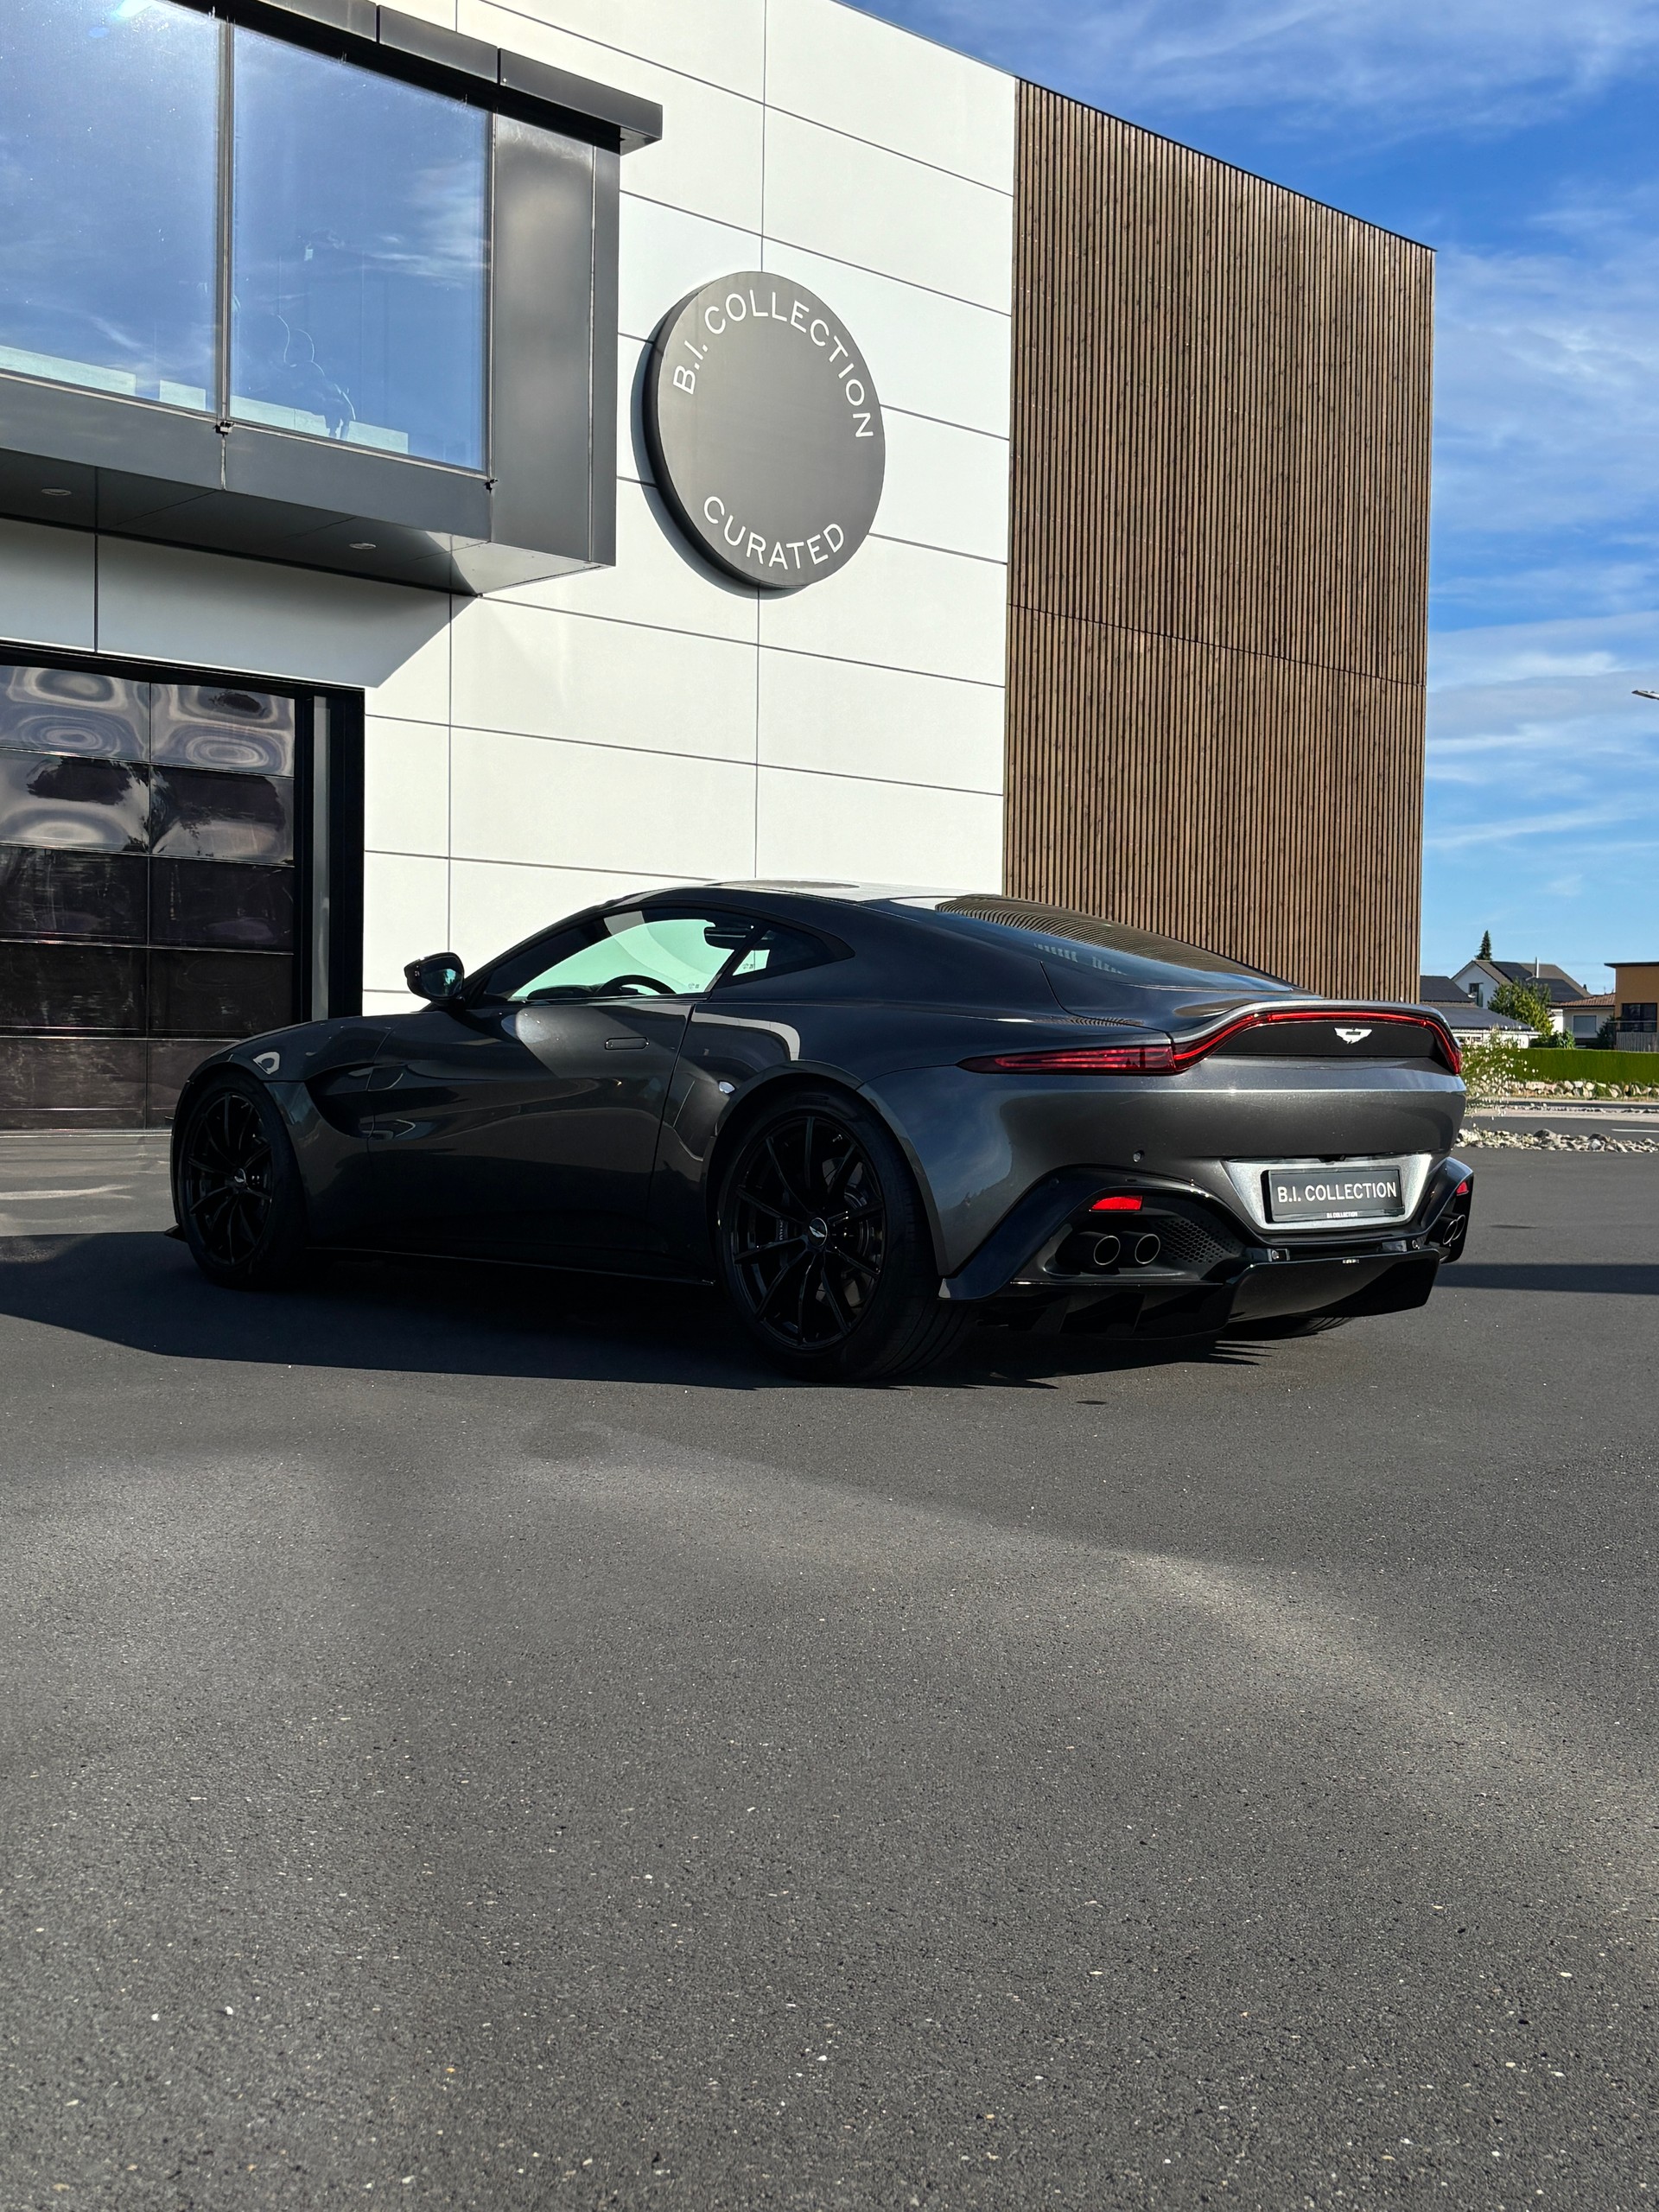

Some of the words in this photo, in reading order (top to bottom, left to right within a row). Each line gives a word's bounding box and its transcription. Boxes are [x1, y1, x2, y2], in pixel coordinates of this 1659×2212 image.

[672, 340, 709, 395] B.I.
[704, 289, 874, 438] COLLECTION
[702, 496, 845, 570] CURATED
[1277, 1186, 1301, 1203] B.I.
[1305, 1182, 1397, 1202] COLLECTION
